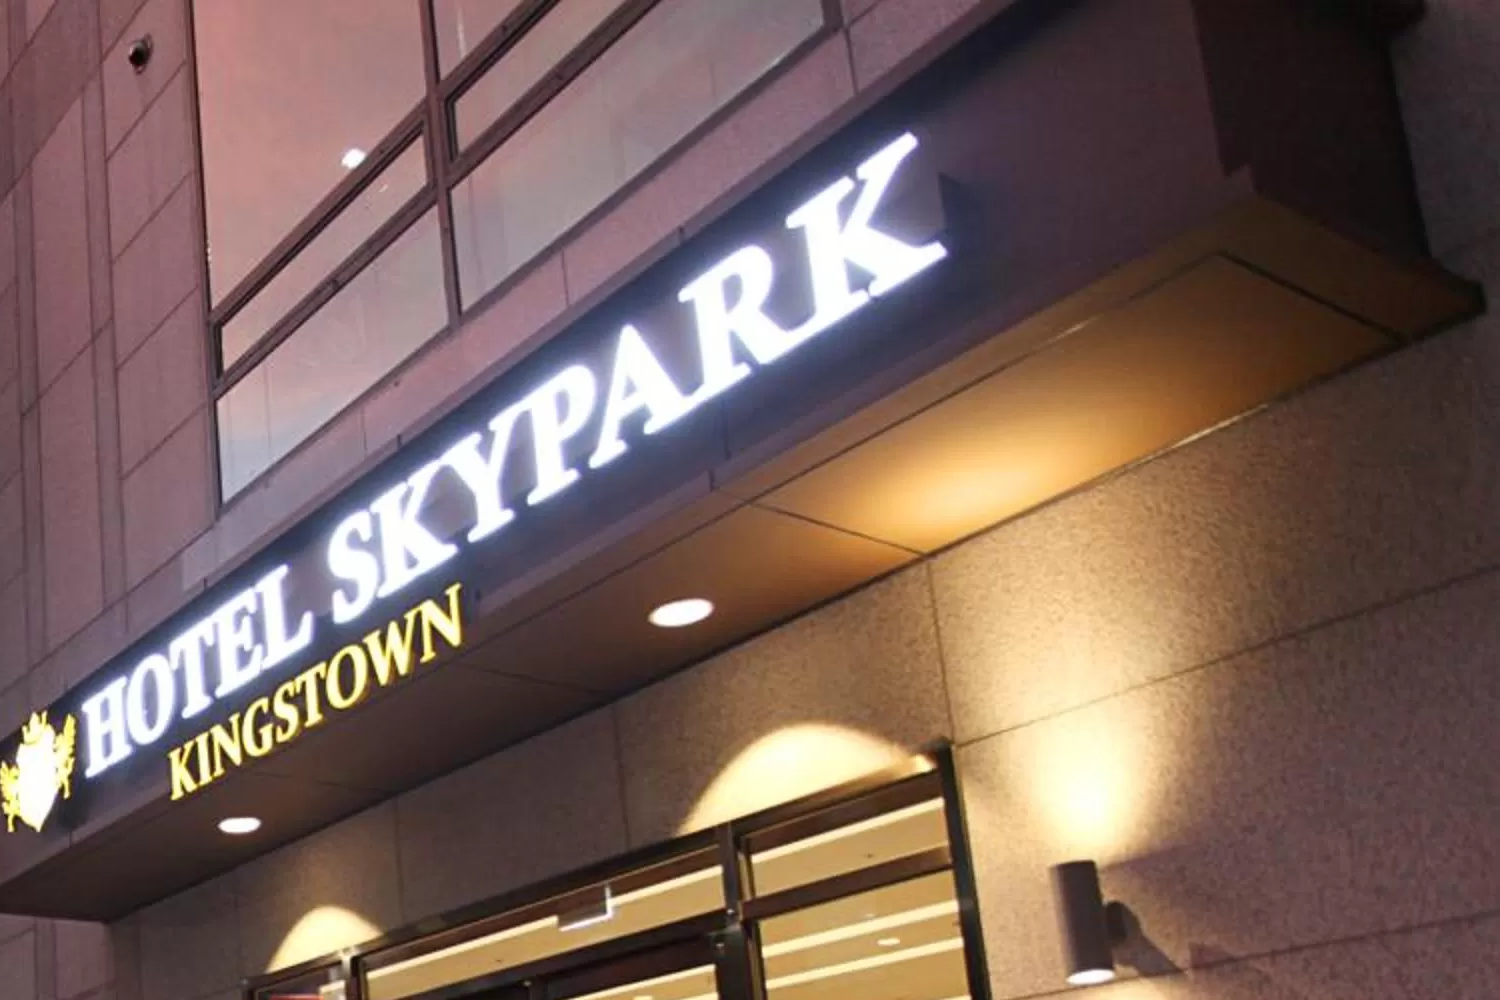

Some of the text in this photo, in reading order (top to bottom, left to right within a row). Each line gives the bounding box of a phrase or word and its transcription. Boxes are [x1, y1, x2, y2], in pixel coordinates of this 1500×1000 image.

[82, 131, 948, 778] HOTEL SKYPARK
[168, 582, 463, 800] KINGSTOWN
